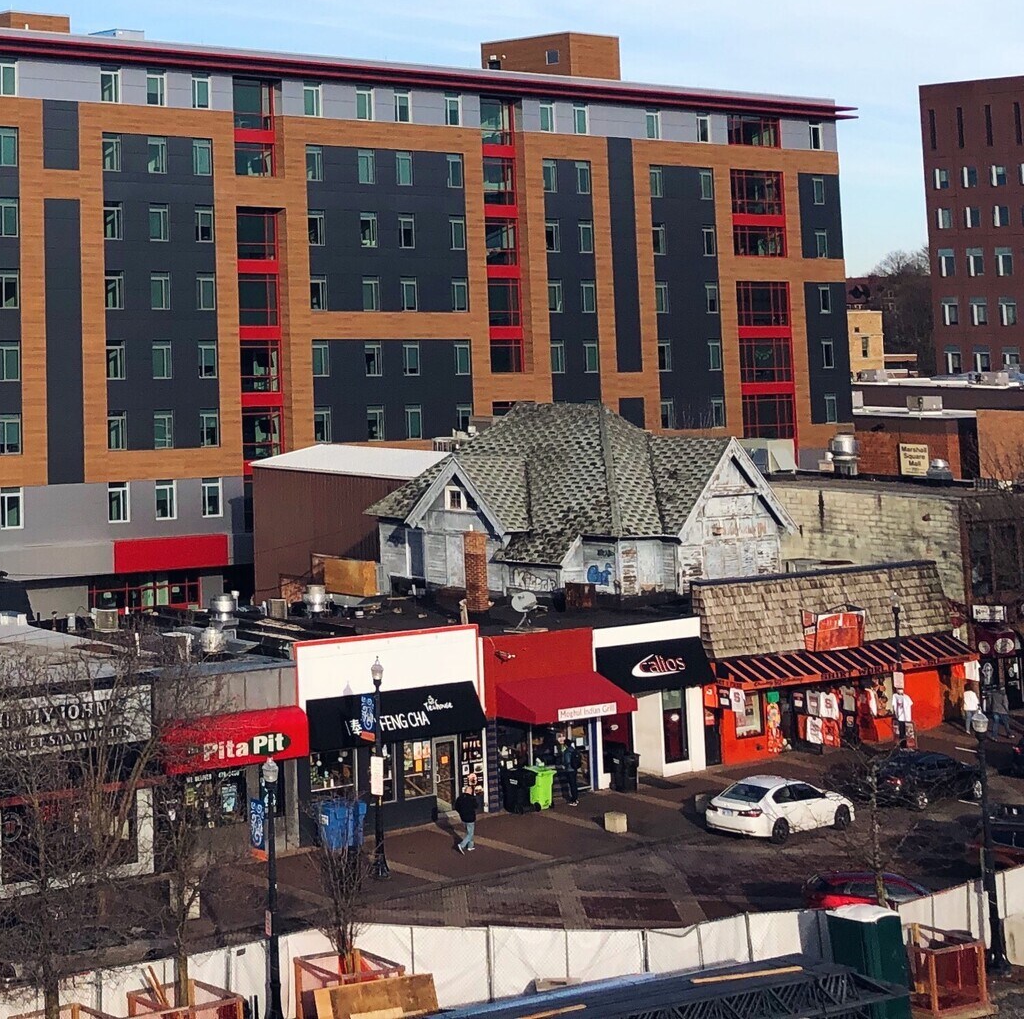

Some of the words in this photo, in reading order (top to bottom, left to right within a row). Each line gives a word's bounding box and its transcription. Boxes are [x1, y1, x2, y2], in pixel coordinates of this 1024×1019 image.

[901, 445, 927, 453] Marshall
[379, 713, 408, 732] FENG
[407, 710, 431, 728] CHA
[203, 740, 249, 762] Pita
[253, 732, 285, 755] Pit
